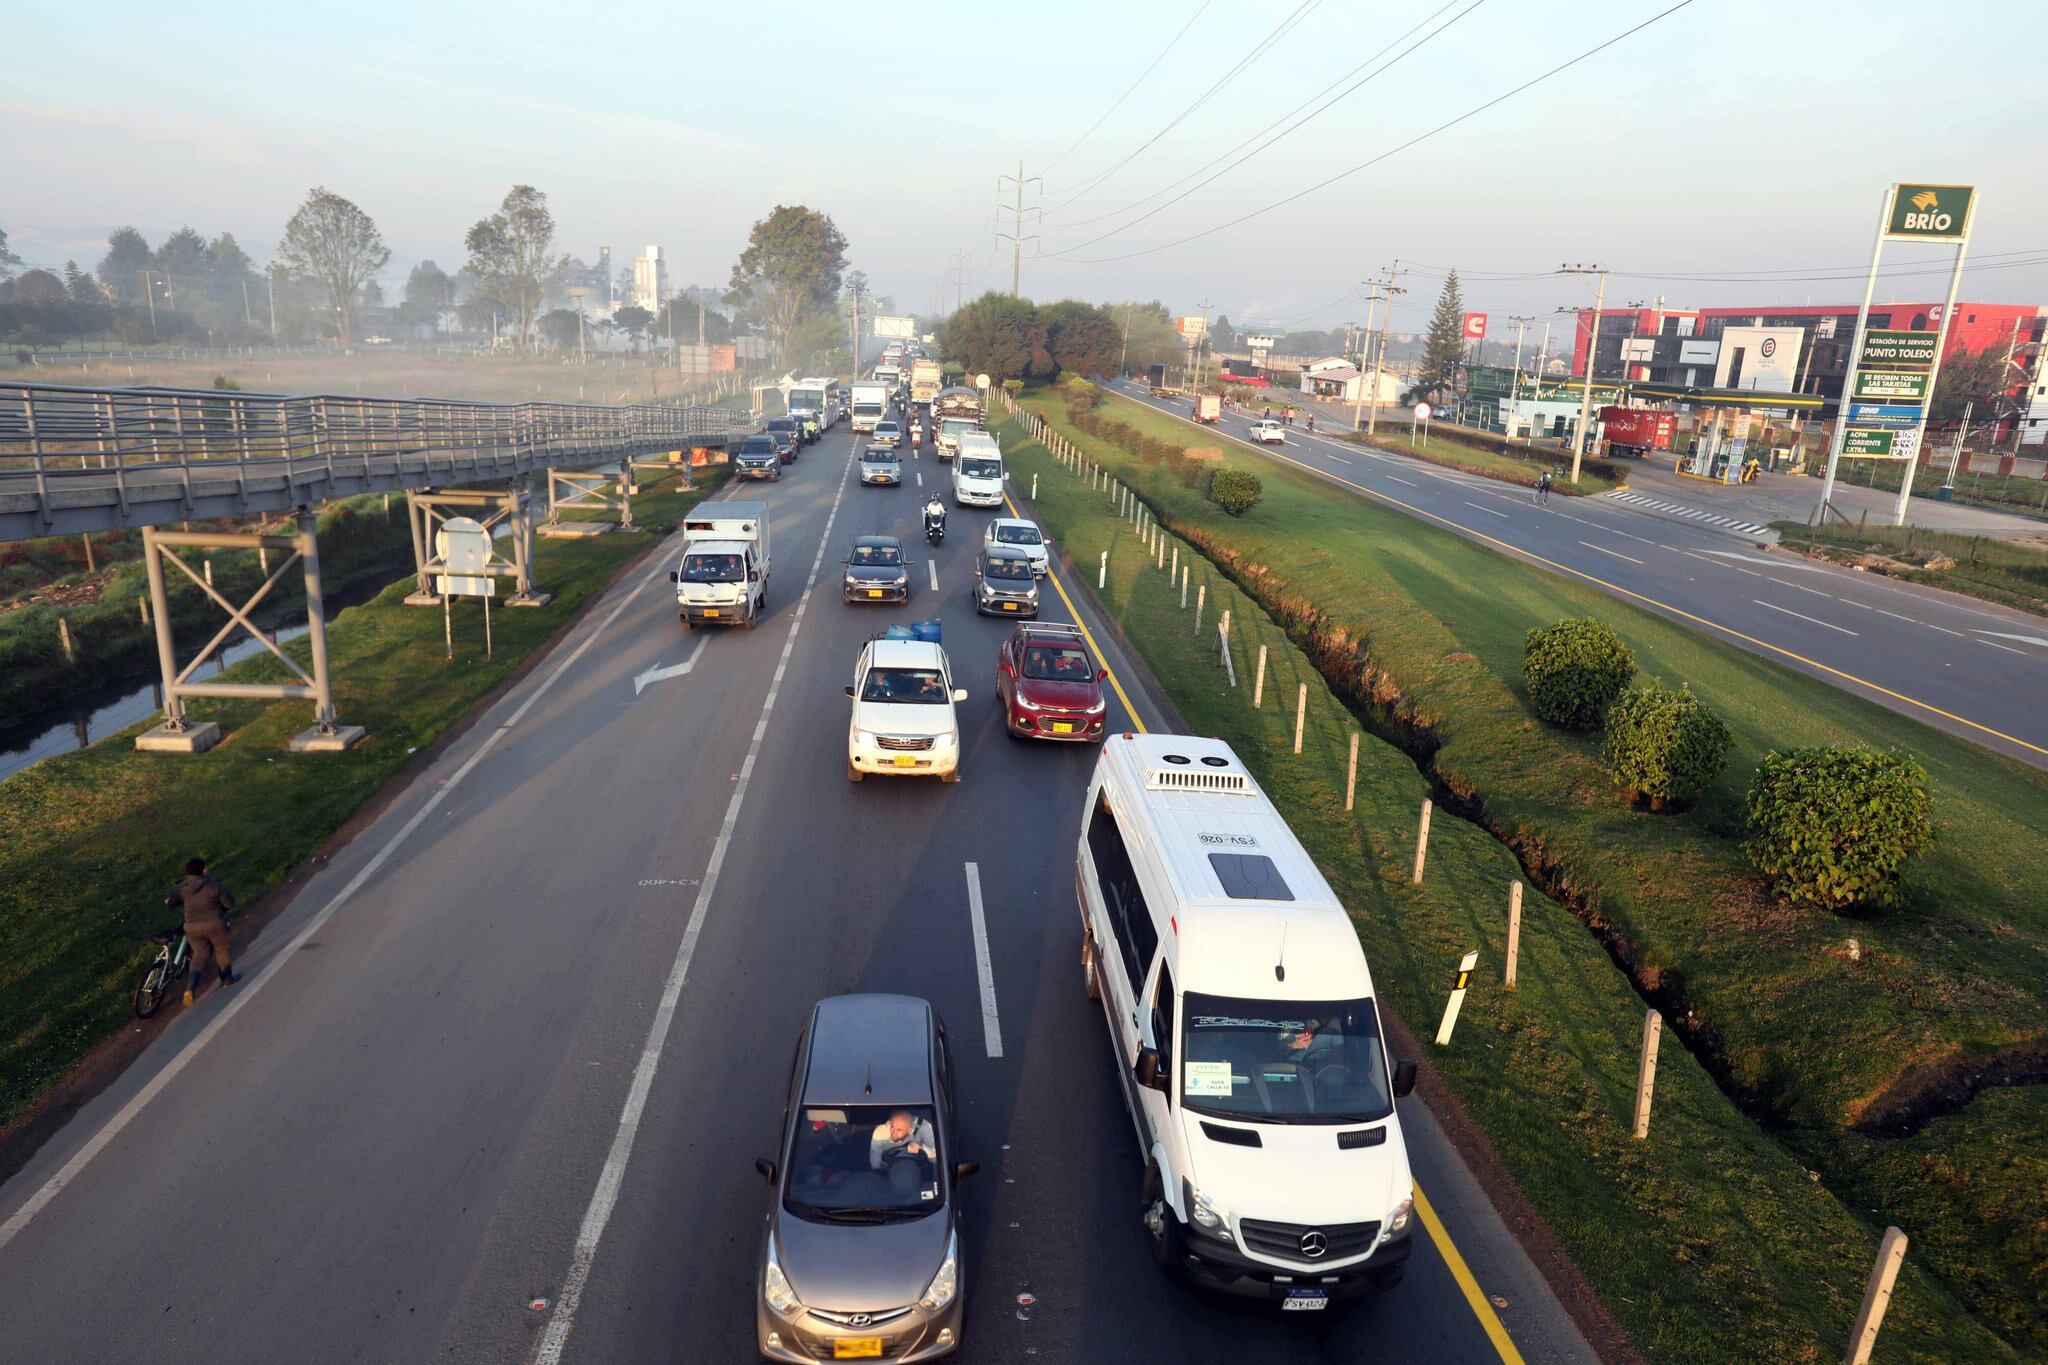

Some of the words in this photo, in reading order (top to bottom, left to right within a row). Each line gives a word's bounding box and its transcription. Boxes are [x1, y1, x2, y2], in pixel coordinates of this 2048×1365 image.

[1904, 208, 1952, 231] BRÍO
[1864, 347, 1897, 357] PUNTO
[1899, 349, 1934, 359] TOLEDO
